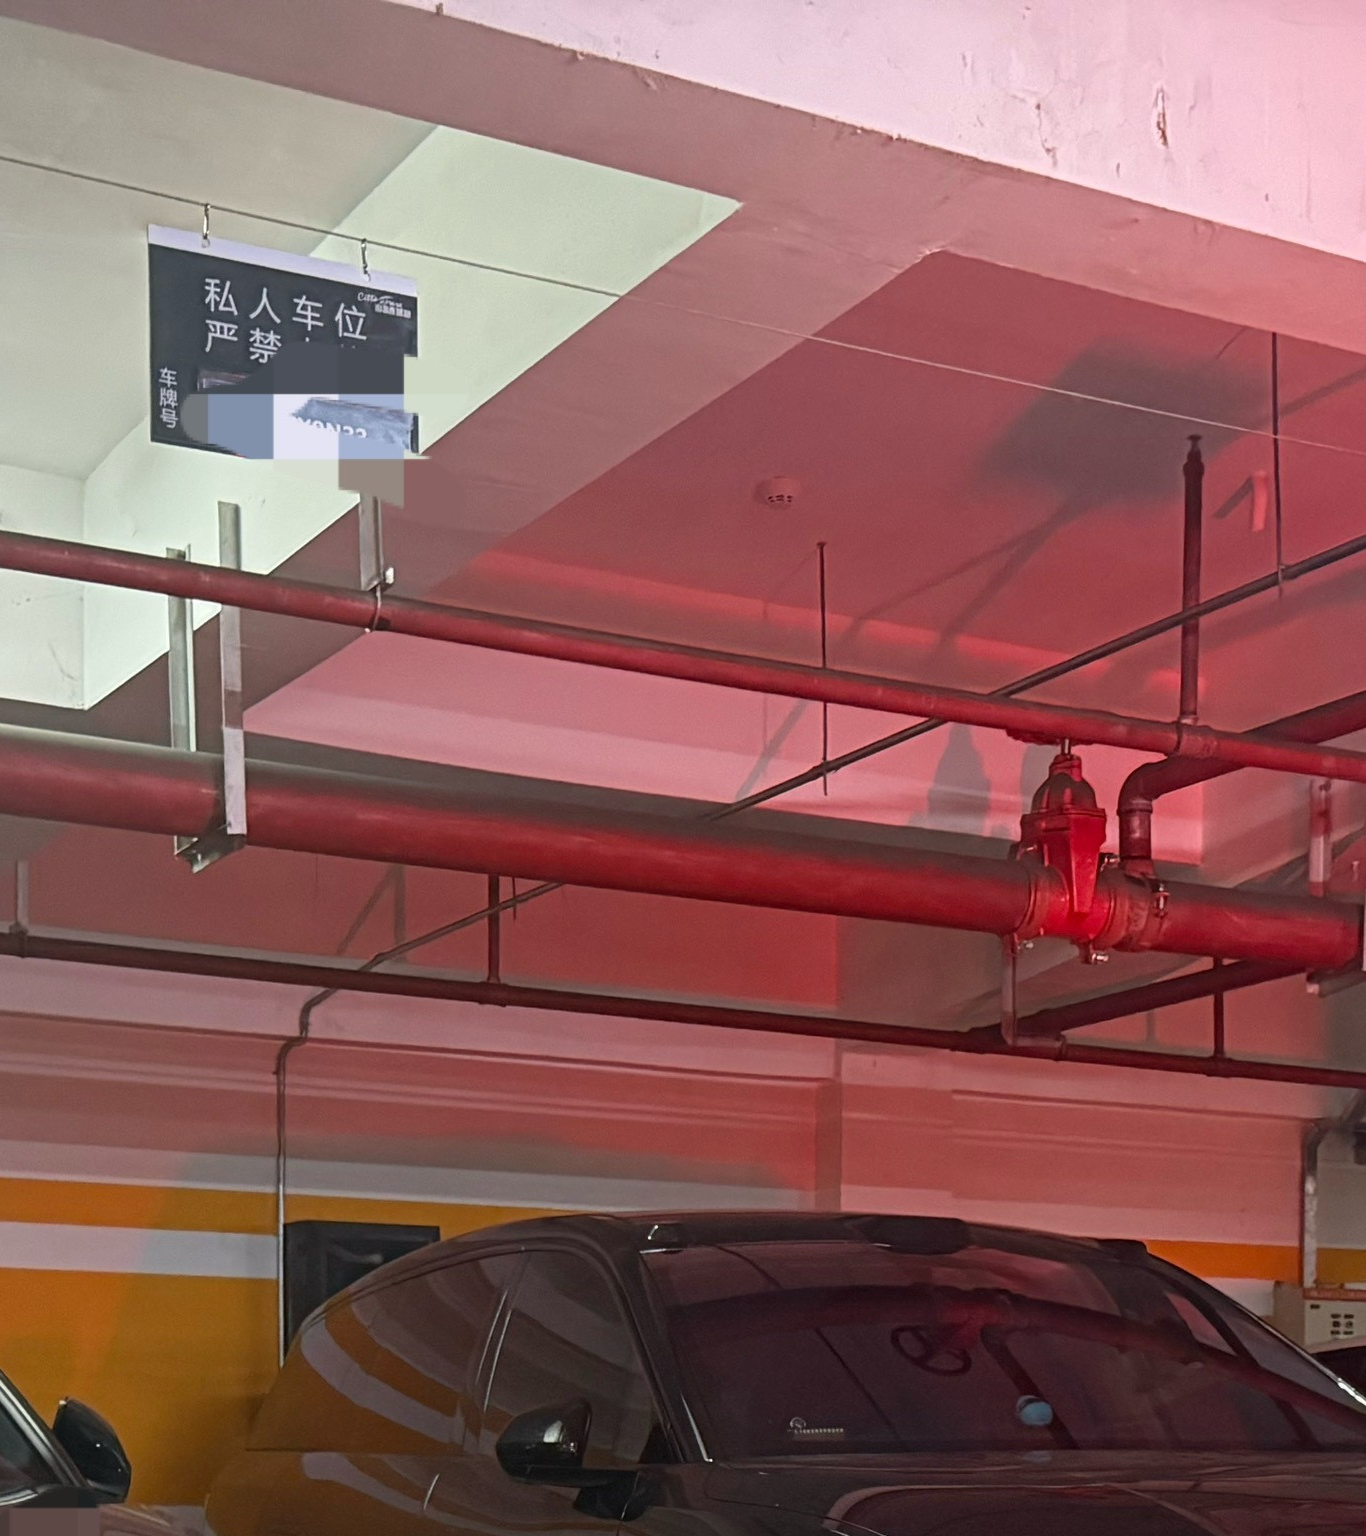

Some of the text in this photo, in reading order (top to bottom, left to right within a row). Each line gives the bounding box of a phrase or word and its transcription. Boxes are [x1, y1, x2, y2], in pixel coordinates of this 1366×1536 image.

[204, 277, 368, 342] 私人车位
[158, 366, 179, 429] 车牌号
